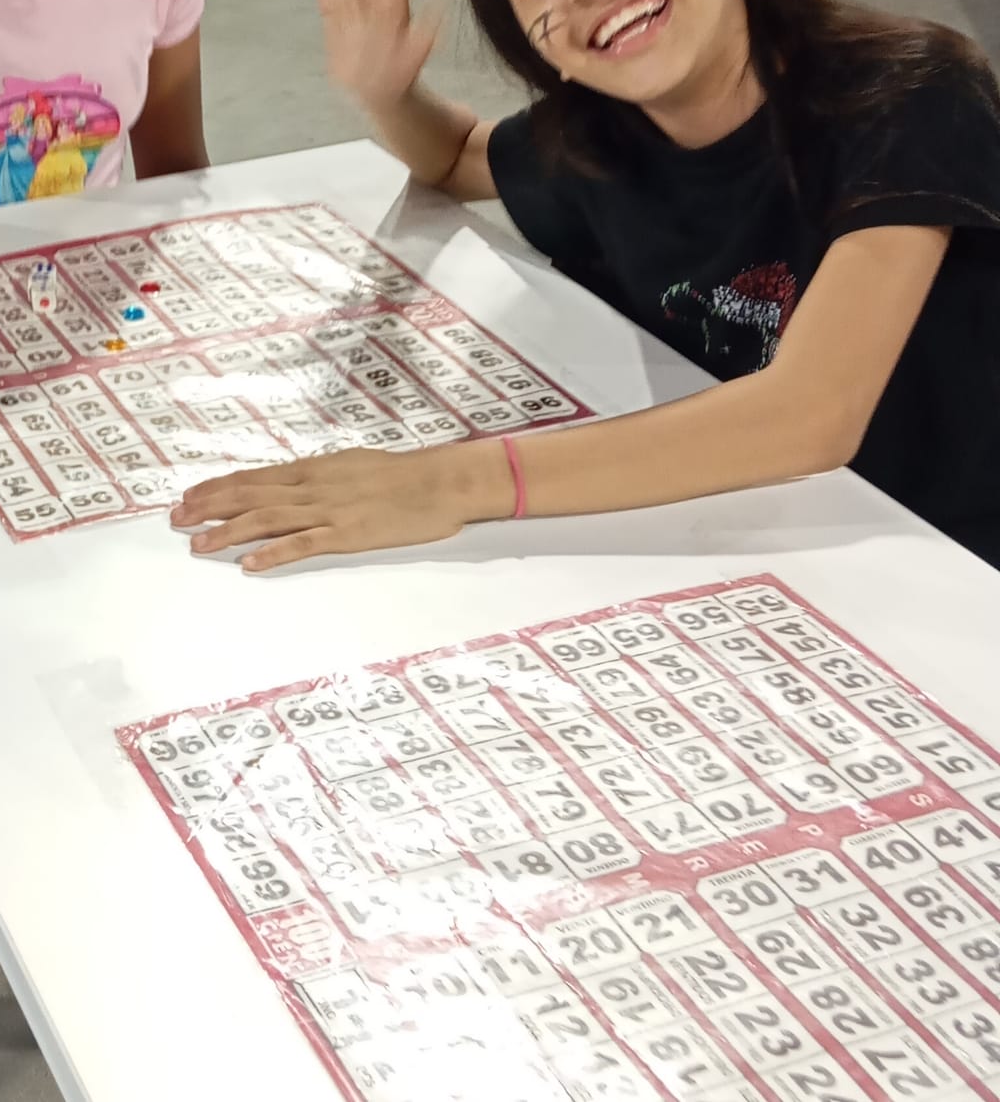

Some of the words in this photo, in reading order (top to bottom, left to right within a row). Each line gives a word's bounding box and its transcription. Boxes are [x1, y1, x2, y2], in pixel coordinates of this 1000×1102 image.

[469, 348, 504, 368] 98
[52, 379, 89, 396] 61
[366, 368, 399, 388] 88
[446, 383, 480, 403] 94
[495, 373, 533, 392] 97
[0, 390, 39, 407] 60
[76, 400, 107, 421] 62
[342, 402, 375, 423] 84
[391, 391, 428, 411] 87
[520, 396, 563, 412] 96
[414, 417, 457, 435] 86
[468, 406, 512, 425] 95
[96, 424, 127, 447] 63
[2, 475, 34, 498] 54
[57, 462, 91, 483] 57
[14, 502, 57, 523] 55
[677, 605, 731, 631] 56
[735, 593, 788, 617] 55
[552, 637, 607, 663] 66
[612, 622, 665, 648] 65
[722, 636, 776, 663] 57
[773, 621, 826, 653] 54
[422, 673, 480, 694] 76
[595, 667, 647, 698] 67
[648, 653, 699, 685] 64
[819, 656, 873, 689] 53
[764, 671, 817, 706] 58
[287, 701, 343, 727] 86
[633, 705, 685, 739] 68
[692, 690, 742, 725] 63
[864, 694, 921, 730] 52
[557, 723, 608, 760] 73
[735, 728, 788, 766] 62
[916, 739, 976, 775] 51
[675, 745, 729, 783] 69
[844, 753, 905, 785] 60
[536, 780, 588, 822] 79
[597, 764, 652, 806] 72
[780, 772, 839, 803] 61
[707, 792, 774, 823] 70
[642, 811, 706, 842] 71
[933, 818, 989, 848] 41
[562, 832, 624, 864] 80
[865, 839, 924, 871] 40
[709, 868, 757, 888] TREINTA
[783, 859, 848, 893] 31
[712, 880, 778, 916] 30
[903, 884, 966, 930] 39
[632, 903, 698, 943] 21
[839, 903, 903, 951] 32
[558, 926, 624, 966] 20
[755, 929, 821, 976] 29
[682, 950, 749, 1000] 22
[894, 958, 960, 1006] 33
[599, 977, 656, 1023] 19
[809, 985, 879, 1035] 28
[536, 993, 591, 1044] 12
[733, 1005, 802, 1057] 23
[649, 1035, 709, 1086] 18
[862, 1048, 937, 1096] 27
